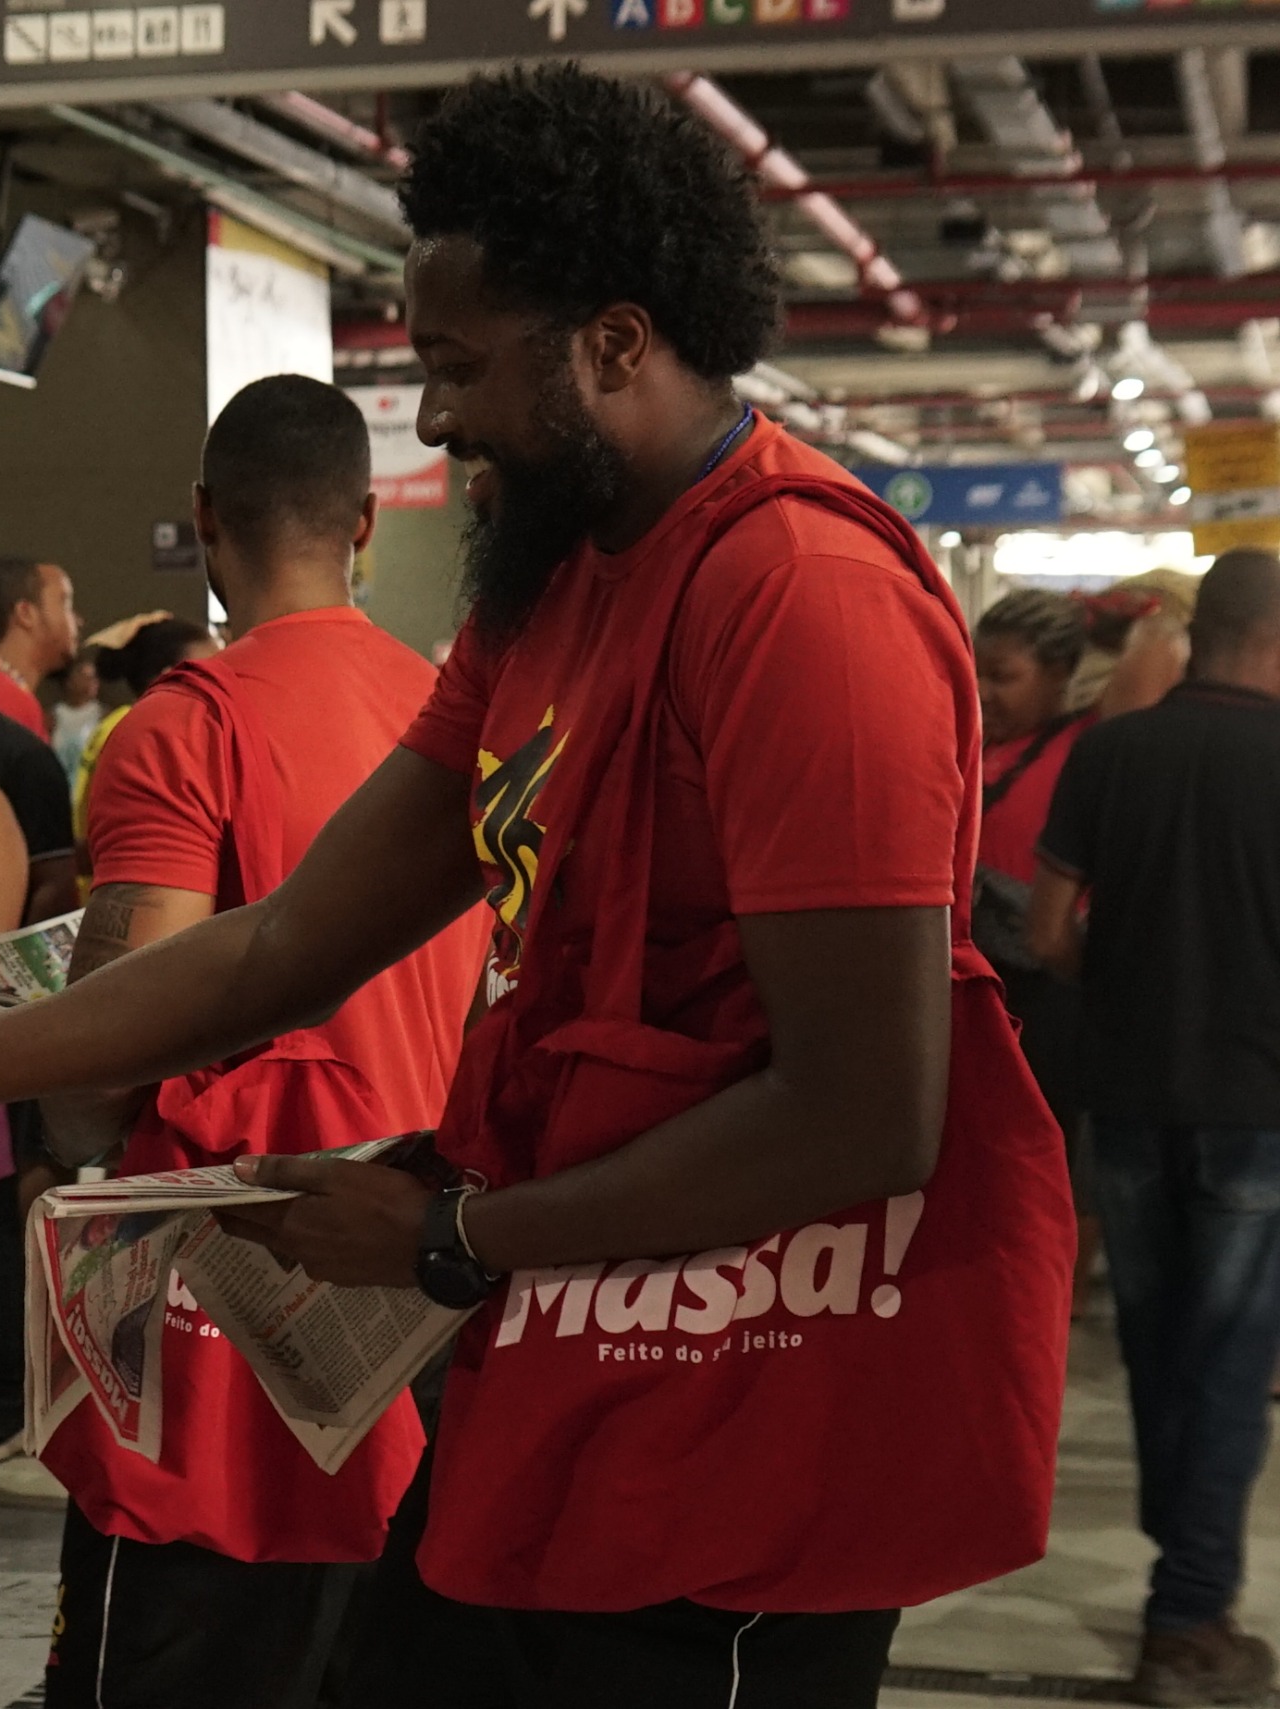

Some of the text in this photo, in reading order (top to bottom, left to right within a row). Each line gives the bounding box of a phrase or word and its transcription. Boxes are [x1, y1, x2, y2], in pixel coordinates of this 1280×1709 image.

[165, 1312, 220, 1338] Feito do
[598, 1343, 663, 1361] Feito
[675, 1345, 703, 1364] do
[742, 1331, 803, 1353] jeito
